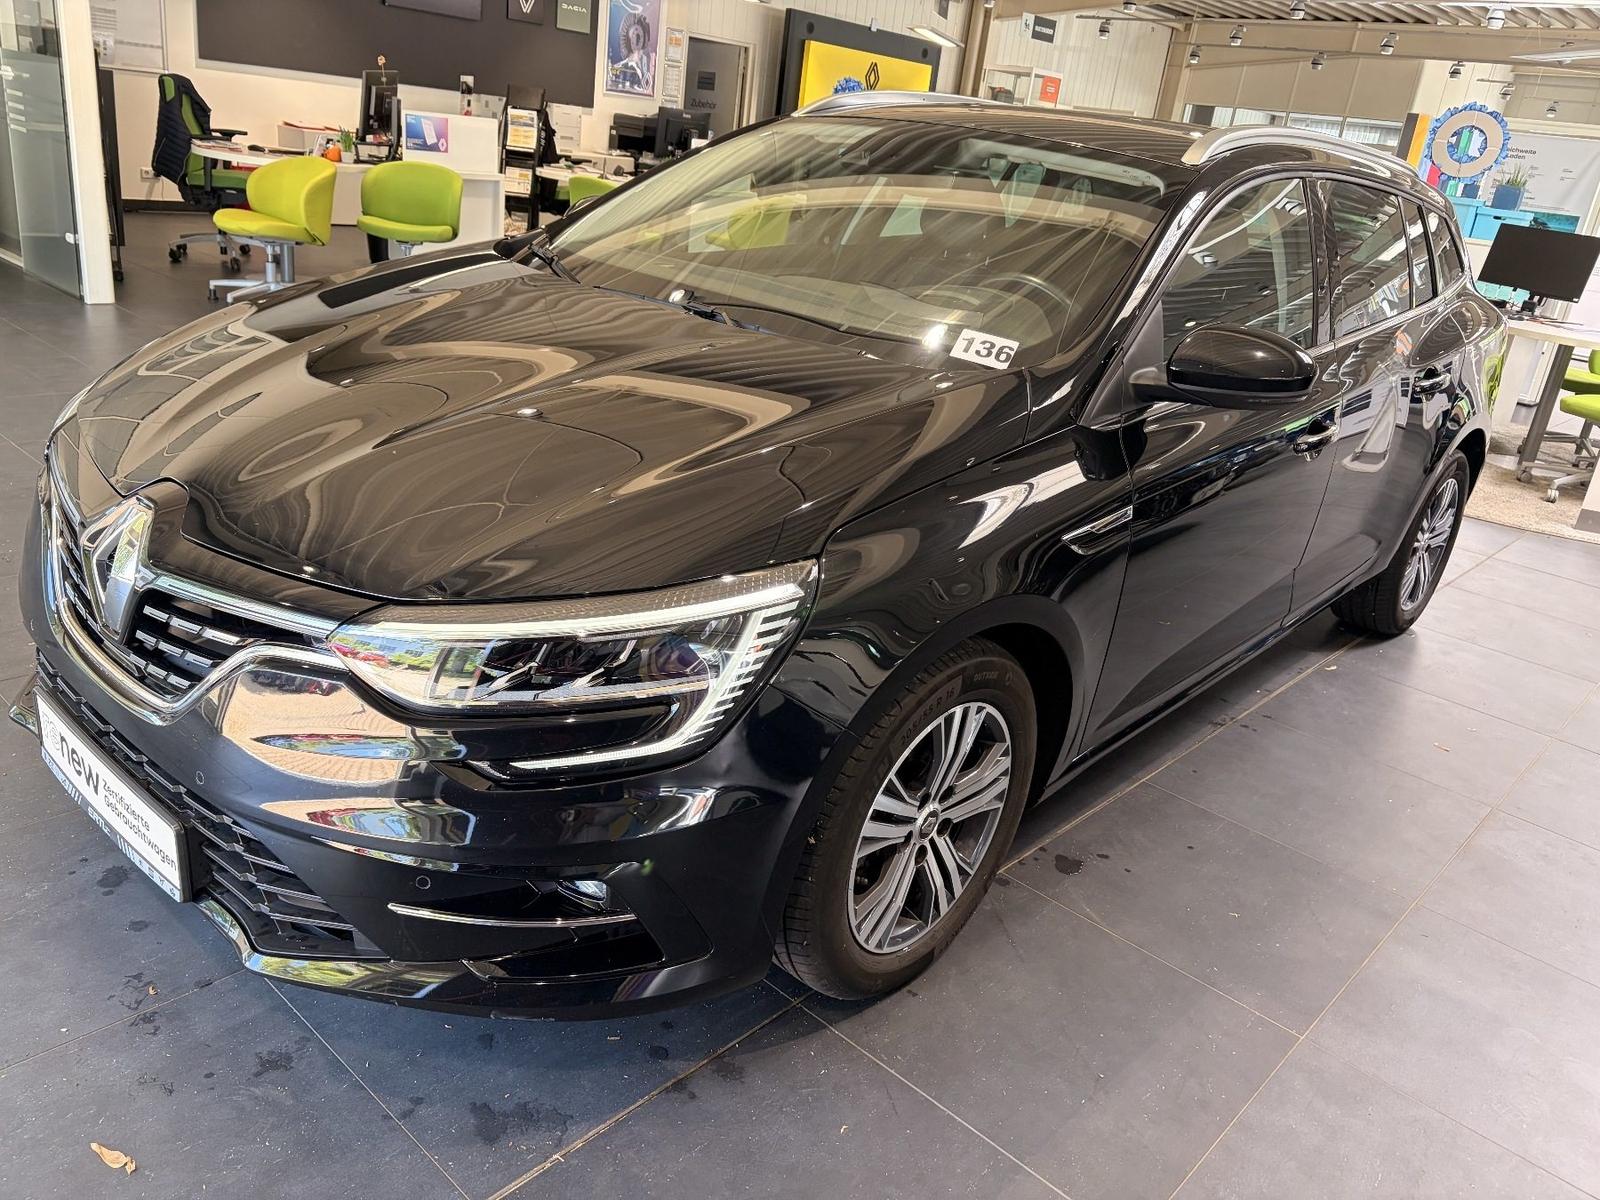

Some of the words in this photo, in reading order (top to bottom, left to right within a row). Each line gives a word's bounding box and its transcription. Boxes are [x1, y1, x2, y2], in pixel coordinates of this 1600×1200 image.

[962, 337, 1015, 363] 136
[102, 778, 150, 832] Zertifizierte
[104, 794, 177, 871] Gebrauchtwagen
